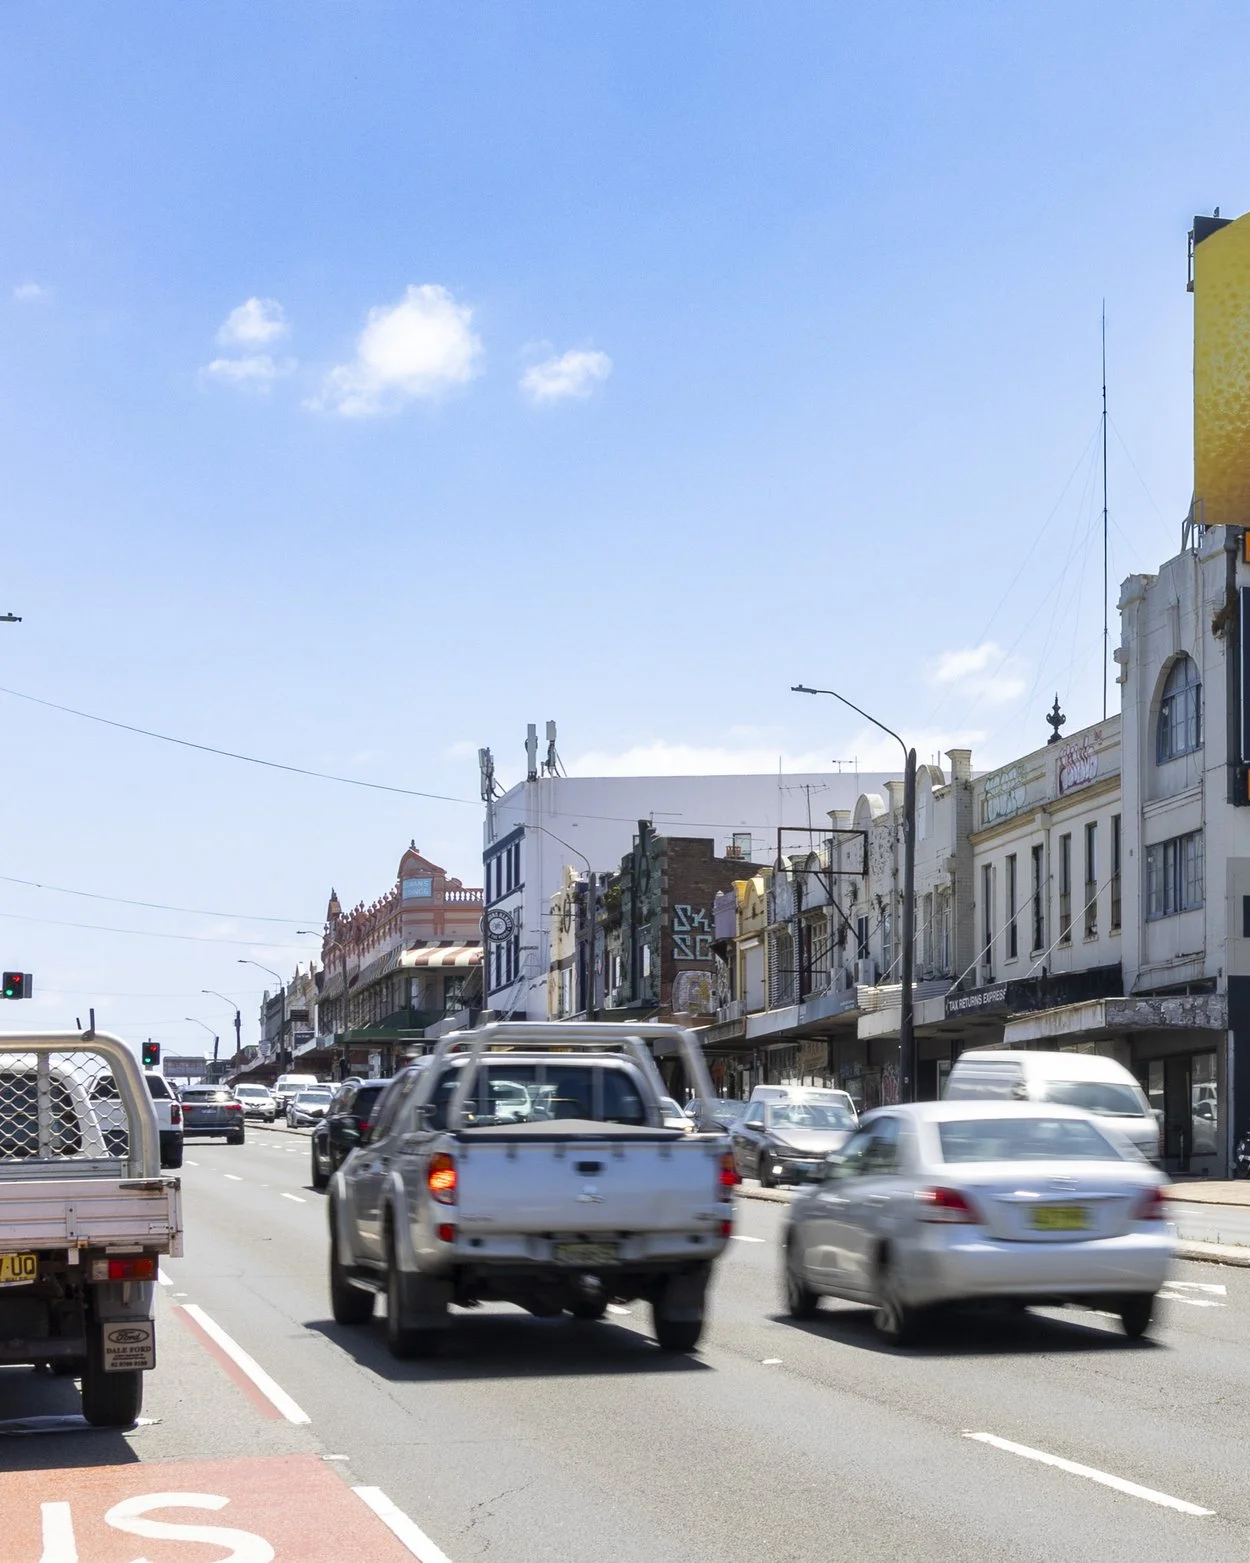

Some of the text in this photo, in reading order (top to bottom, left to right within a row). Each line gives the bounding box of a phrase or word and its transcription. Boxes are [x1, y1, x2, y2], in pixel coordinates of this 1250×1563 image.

[948, 1000, 959, 1012] TAX
[958, 993, 982, 1009] RETURNS
[106, 1345, 152, 1354] DALE FORD
